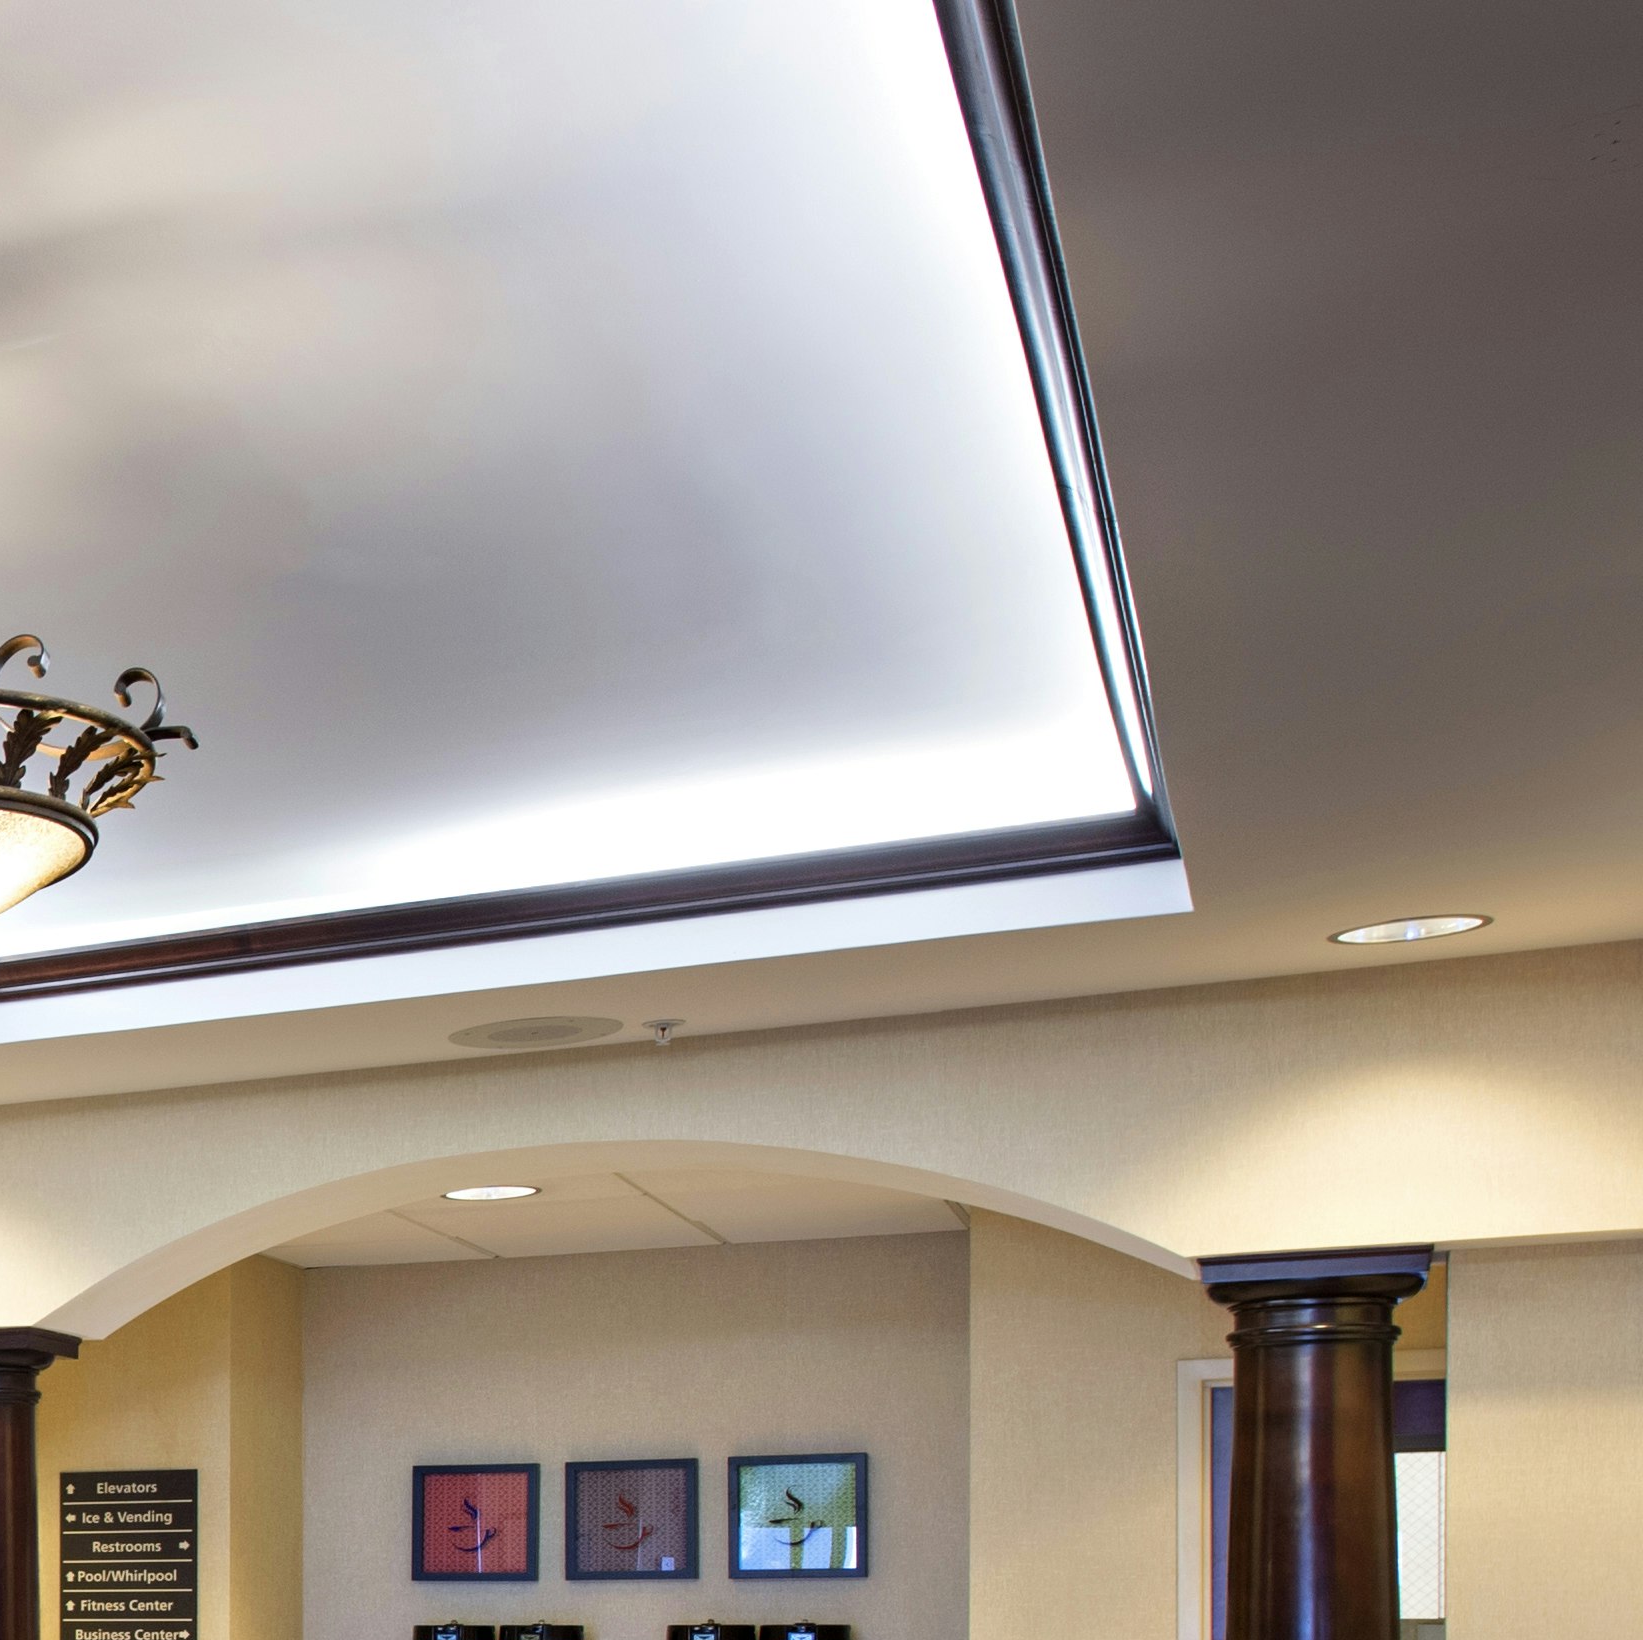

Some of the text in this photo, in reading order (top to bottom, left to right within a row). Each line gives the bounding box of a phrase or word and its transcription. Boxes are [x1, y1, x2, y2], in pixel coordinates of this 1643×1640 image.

[96, 1482, 158, 1494] Elevators
[82, 1510, 173, 1525] Ice & Vending
[92, 1541, 162, 1553] Restrooms
[77, 1569, 177, 1584] Pool/Whirlpool
[80, 1599, 173, 1611] Fitness Center
[75, 1629, 179, 1640] Business Center
